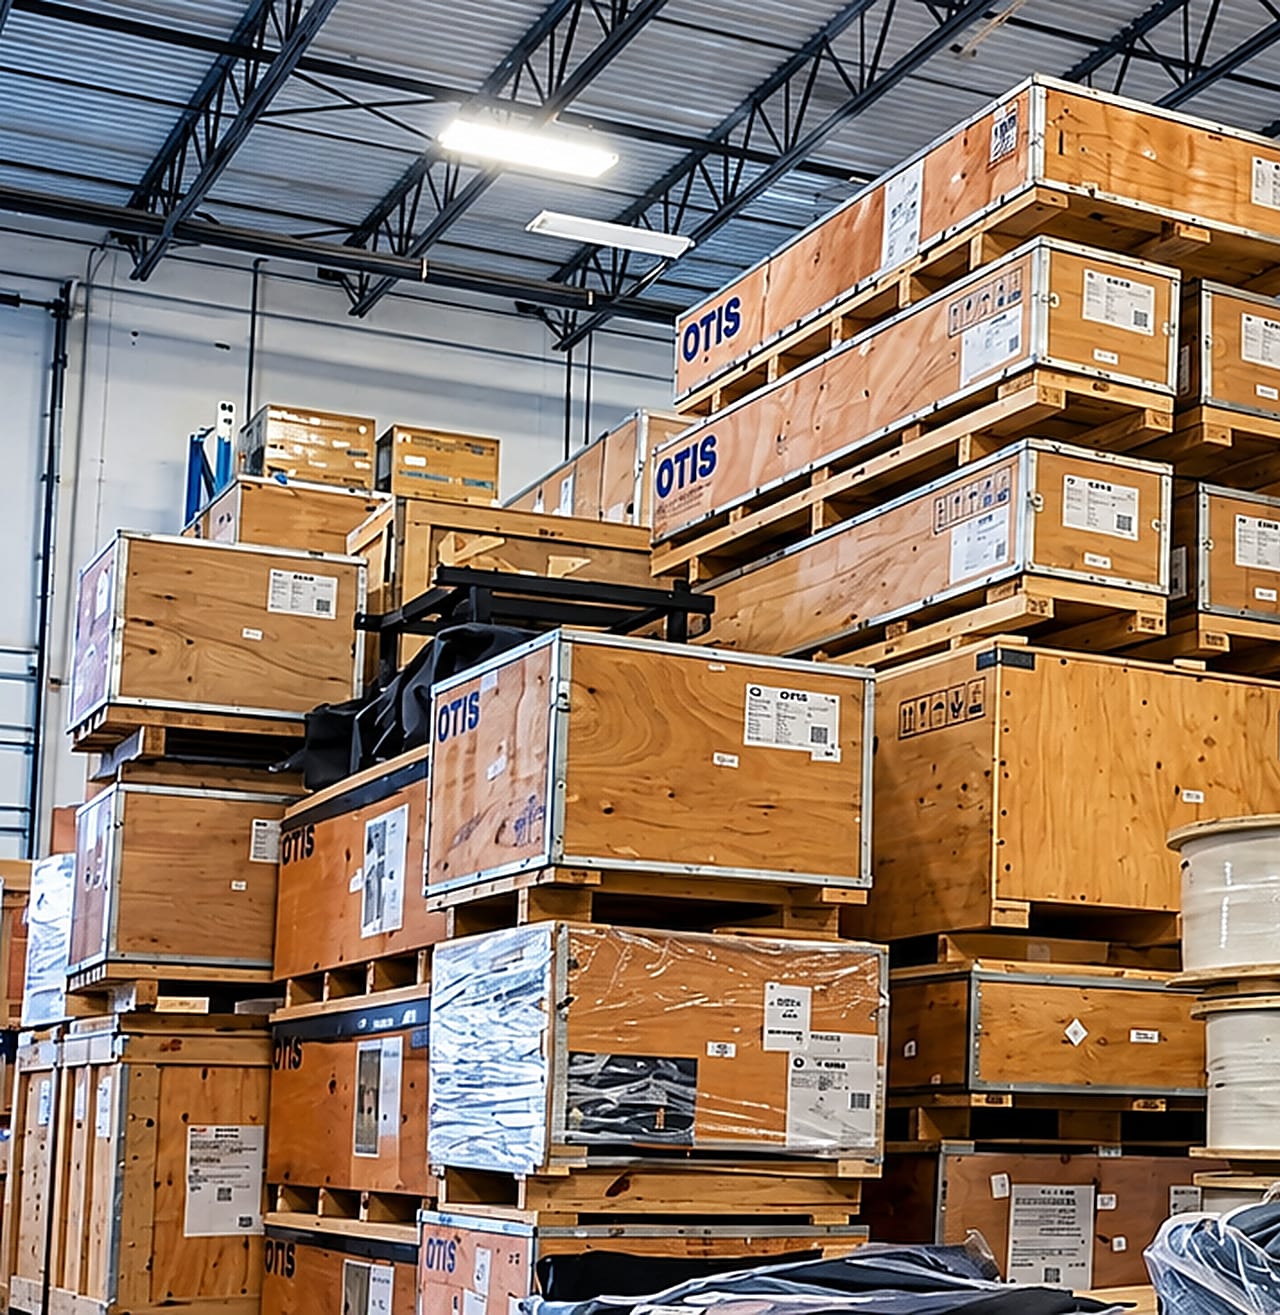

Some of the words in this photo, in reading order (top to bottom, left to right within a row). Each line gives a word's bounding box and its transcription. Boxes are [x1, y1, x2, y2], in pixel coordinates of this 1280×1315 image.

[682, 298, 741, 363] OTIS
[655, 436, 718, 499] OTIS
[438, 692, 480, 743] OTIS
[281, 825, 315, 866] OTIS
[272, 1038, 303, 1070] OTIS
[264, 1240, 296, 1278] OTIS
[425, 1238, 455, 1274] OTIS
